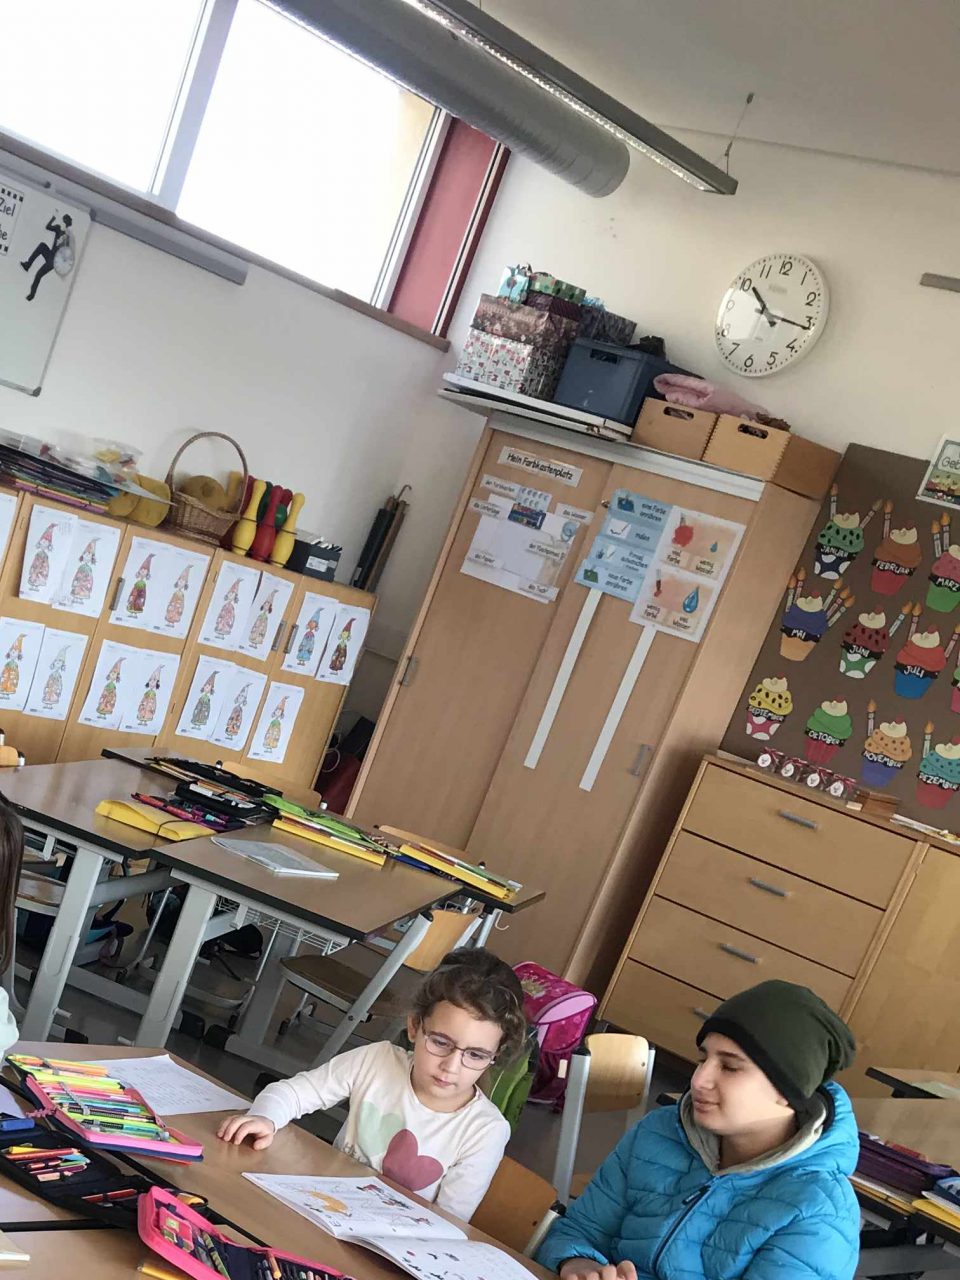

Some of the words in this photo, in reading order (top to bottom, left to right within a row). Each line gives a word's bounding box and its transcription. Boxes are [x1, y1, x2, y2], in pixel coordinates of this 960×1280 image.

[759, 263, 772, 279] 11
[779, 260, 793, 276] 12
[740, 277, 753, 292] 10
[801, 271, 808, 286] 1
[805, 291, 817, 307] 2
[804, 315, 814, 330] 3
[728, 342, 740, 356] 7
[785, 338, 798, 353] 4
[744, 354, 754, 368] 6
[766, 351, 779, 366] 5
[820, 545, 849, 558] JANUAR
[876, 559, 910, 575] FEBRUAR
[791, 628, 806, 639] MAI
[849, 644, 870, 658] JUNI
[903, 665, 925, 678] JULI
[748, 705, 785, 722] SEPTEMBER
[808, 730, 841, 745] OKTOBER
[863, 750, 903, 769] NOVEMBER
[918, 773, 959, 791] DEZEMBER
